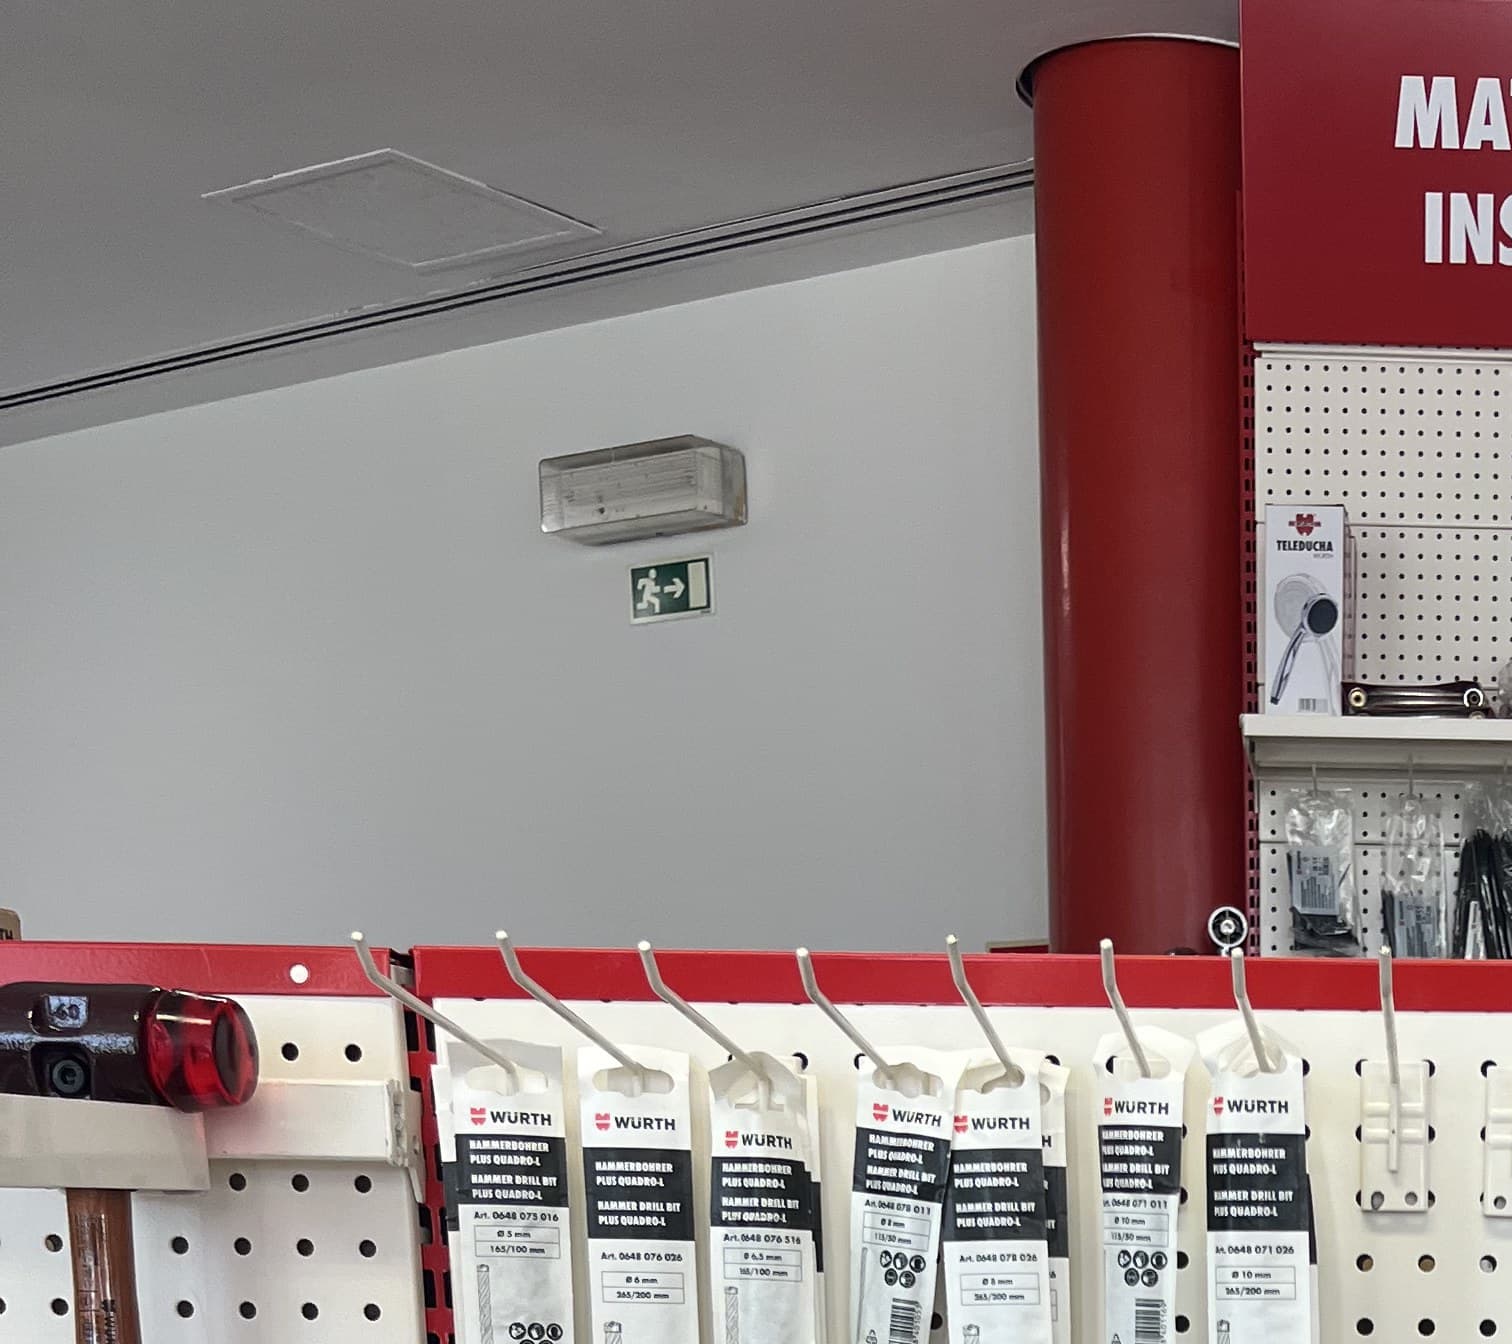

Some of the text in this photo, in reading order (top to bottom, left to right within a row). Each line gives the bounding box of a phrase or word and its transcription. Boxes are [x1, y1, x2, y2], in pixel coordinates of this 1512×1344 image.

[1276, 540, 1334, 552] TELEDUCHA
[491, 1111, 552, 1126] WÜRTH
[615, 1116, 676, 1131] WÜRTH
[742, 1134, 792, 1150] WÜRTH
[470, 1154, 541, 1167] PLUS QUADRO-L
[473, 1188, 542, 1200] PLUS QUADRO-L
[1228, 1245, 1294, 1255] 0648 071 026
[601, 1252, 616, 1261] Art.
[619, 1252, 644, 1262] 0648
[648, 1252, 663, 1262] 076
[1242, 1271, 1252, 1279] 10
